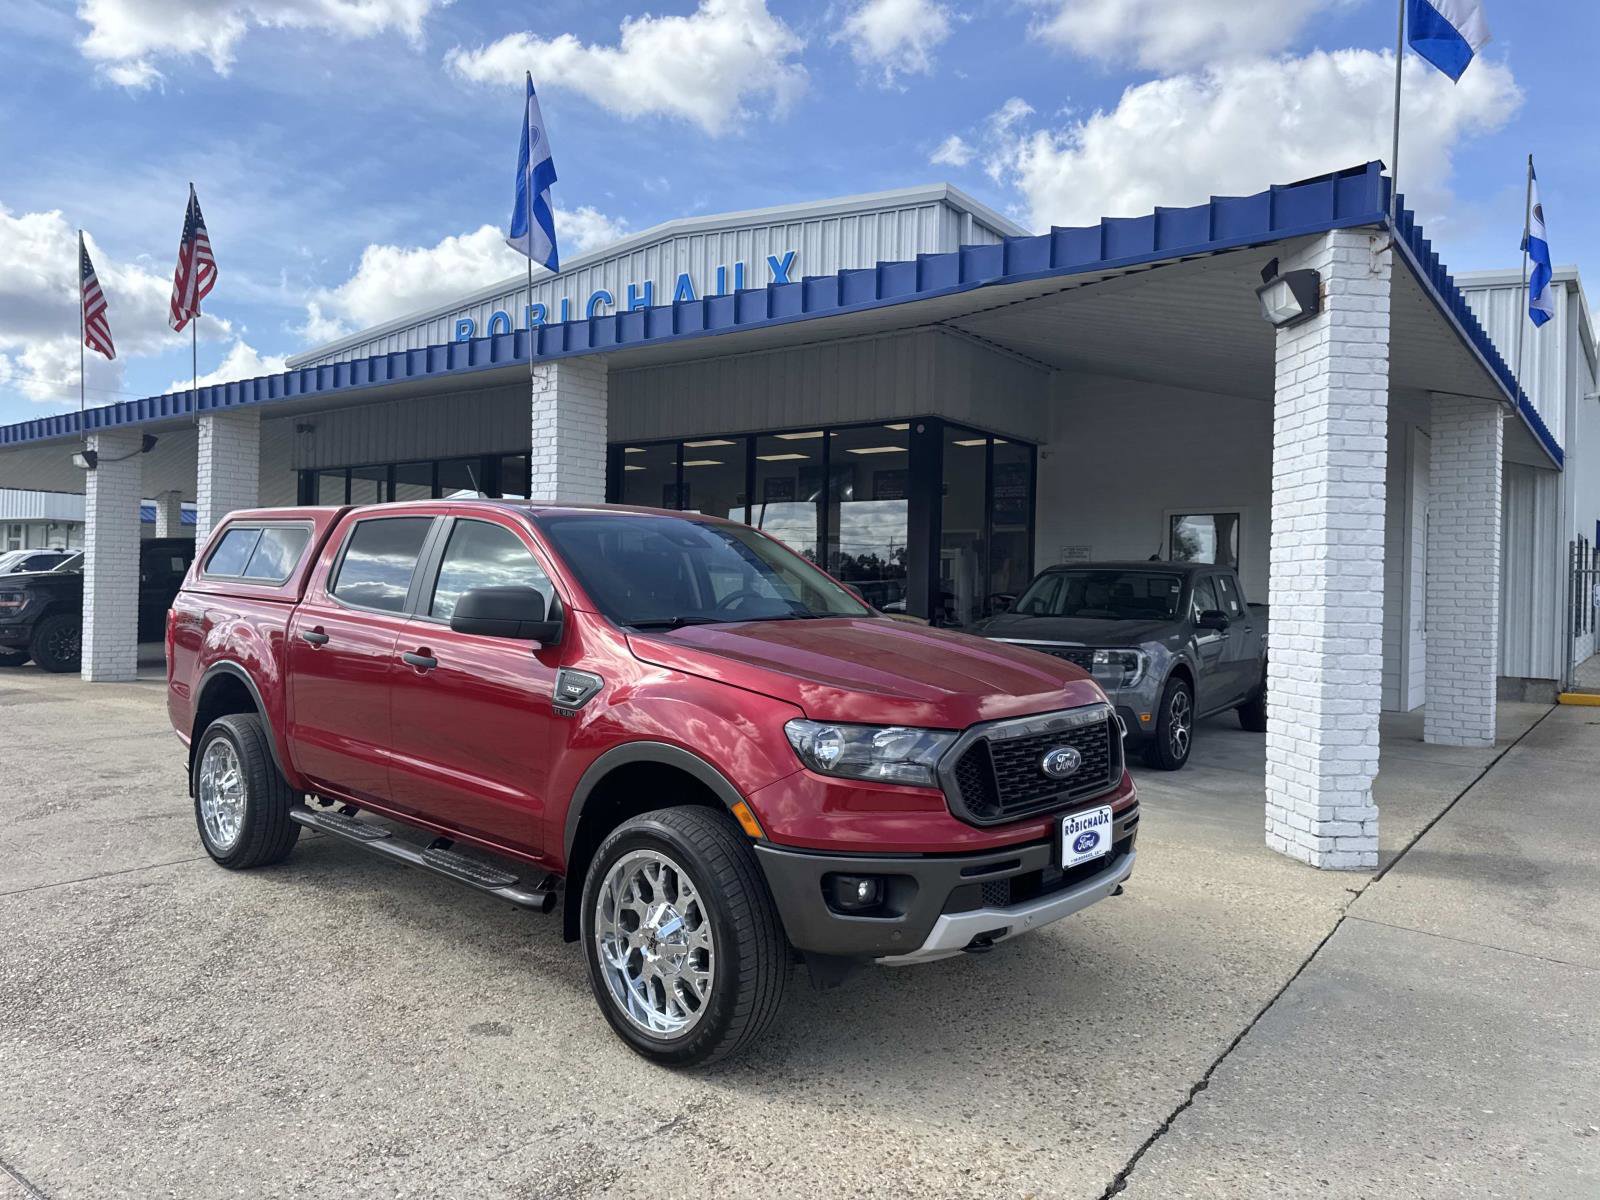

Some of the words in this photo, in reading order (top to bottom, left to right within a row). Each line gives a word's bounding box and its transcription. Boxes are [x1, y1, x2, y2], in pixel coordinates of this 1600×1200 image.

[454, 250, 798, 343] ROBICHAUX
[566, 686, 582, 694] XLT
[1056, 753, 1076, 771] Ford
[1064, 813, 1109, 836] ROBICHAUX
[1077, 834, 1096, 851] Ford
